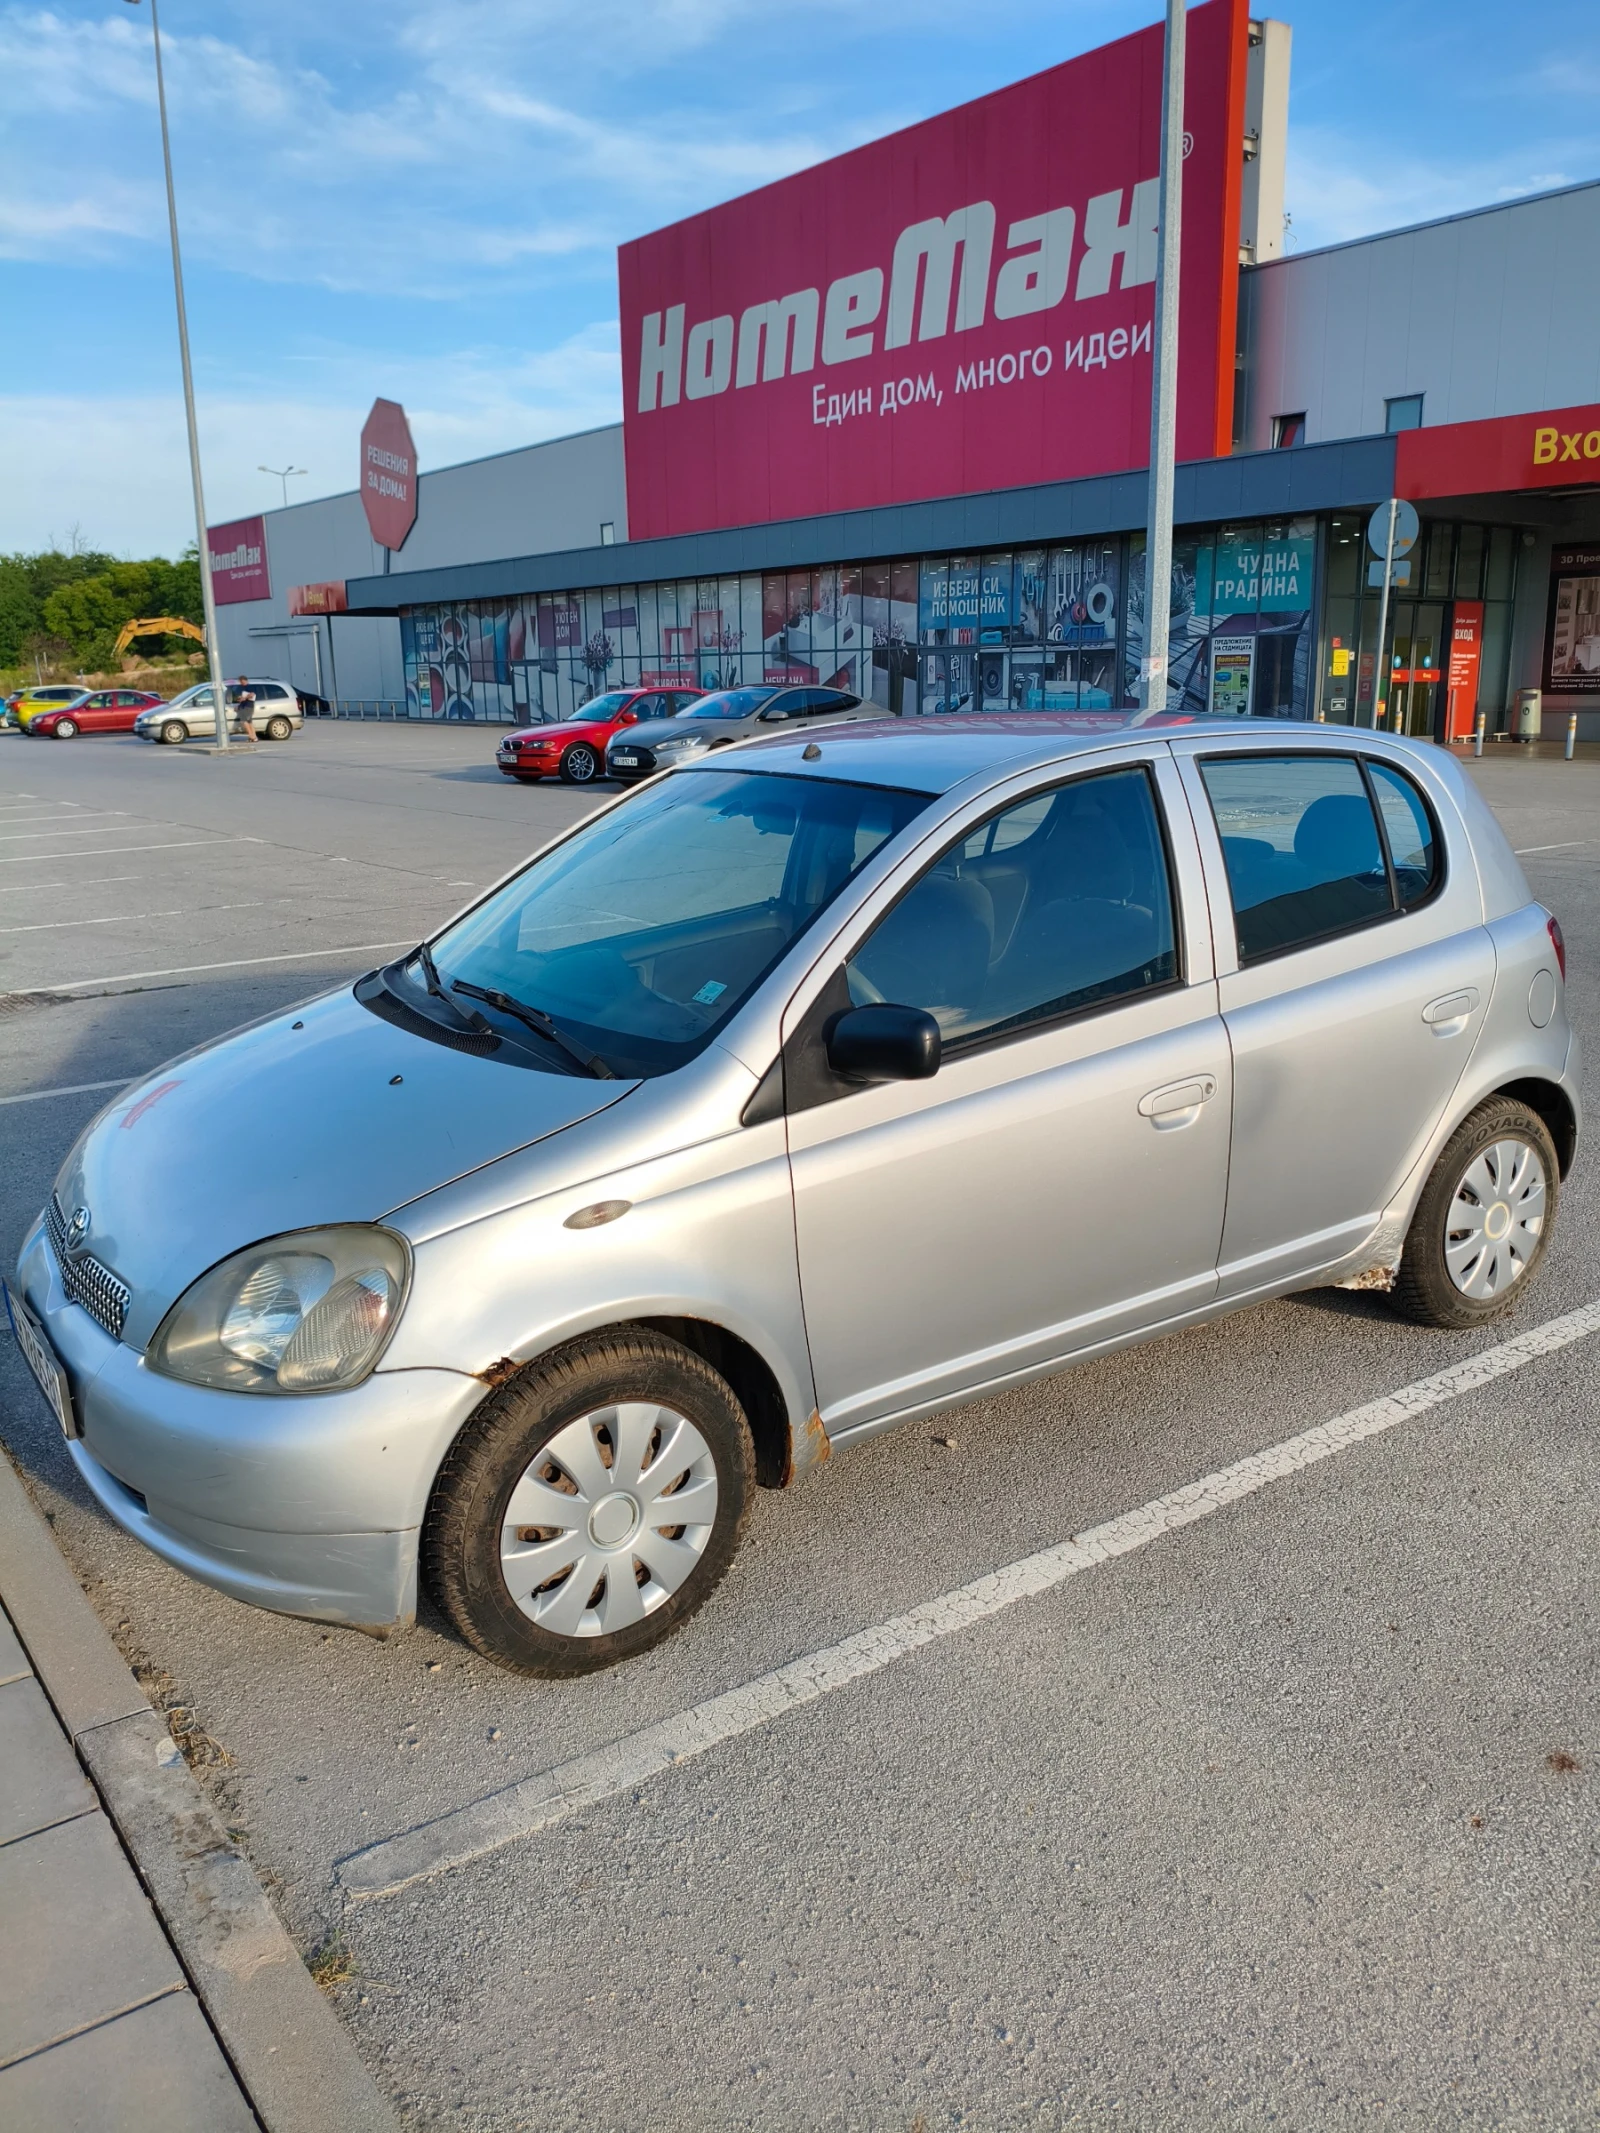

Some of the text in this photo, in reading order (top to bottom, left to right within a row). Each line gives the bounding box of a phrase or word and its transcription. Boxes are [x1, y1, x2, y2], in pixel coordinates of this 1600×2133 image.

[638, 176, 1160, 414] HomeMax
[812, 320, 1152, 427] Един дом, много идеи
[1533, 427, 1600, 465] Вхо
[367, 445, 408, 476] РЕШЕНИЯ
[367, 471, 407, 501] ЗА ДОМА!
[1238, 552, 1300, 577] ЧУДНА
[933, 577, 999, 598] ИЗБЕРИ СИ
[1215, 575, 1299, 601] ГРАДИНА
[555, 611, 578, 624] УЮТЕН
[932, 596, 1006, 618] ПОМОЩНИК
[556, 625, 570, 640] ДОМ
[1454, 629, 1474, 641] ВХОД
